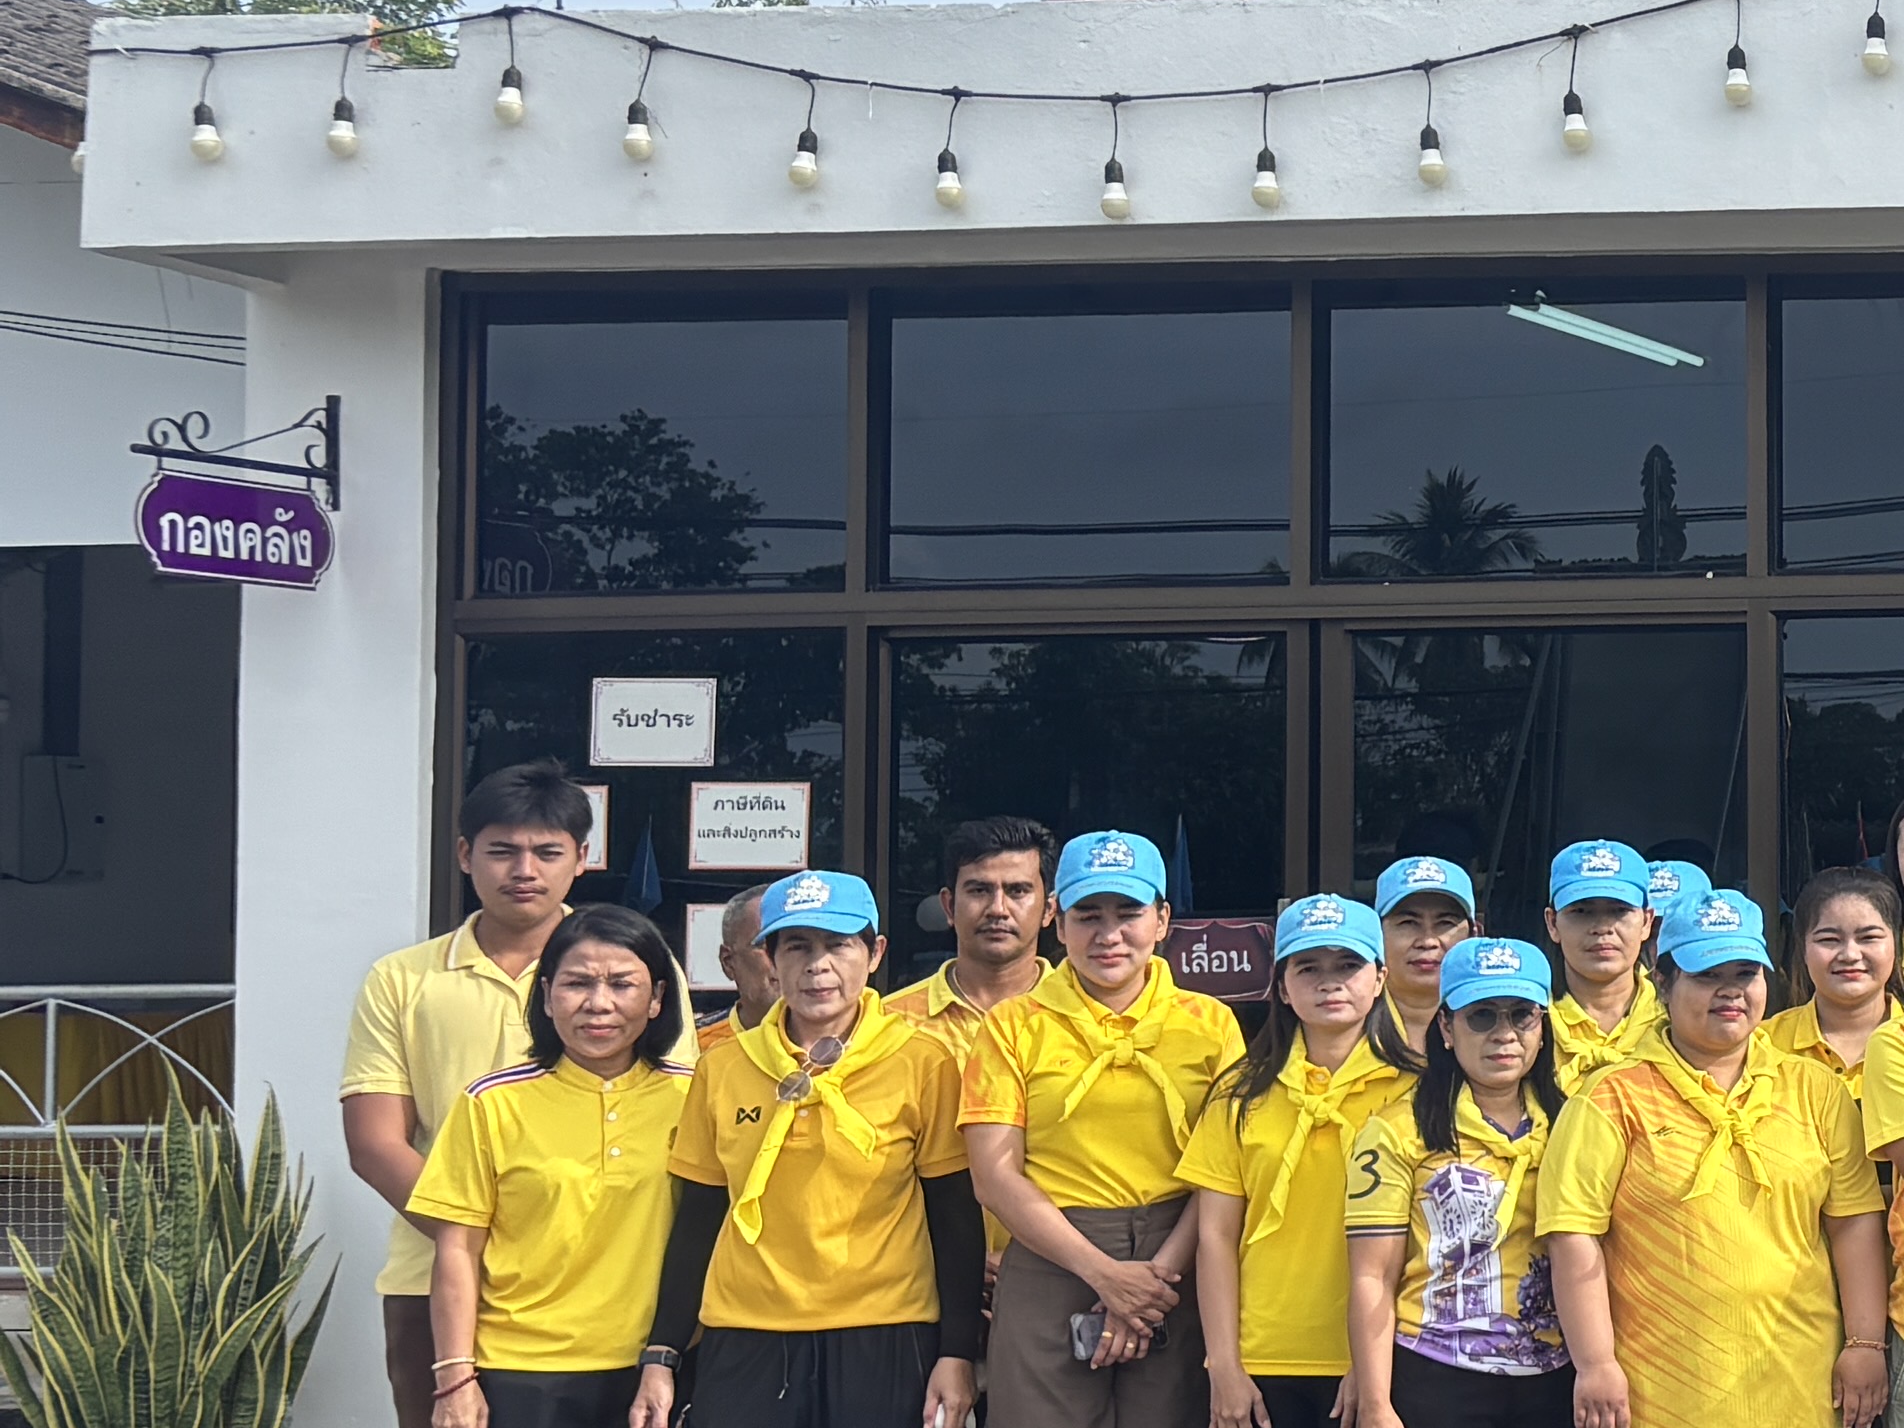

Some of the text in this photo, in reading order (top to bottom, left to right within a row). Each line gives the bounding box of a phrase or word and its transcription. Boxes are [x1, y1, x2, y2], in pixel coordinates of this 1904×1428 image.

[159, 505, 313, 569] กองคลัง
[612, 707, 695, 728] รับชำระ
[712, 791, 786, 812] ภาษีที่ดิน
[697, 822, 801, 843] และสิ่งปลูกสร้าง
[1181, 933, 1252, 974] เลื่อน
